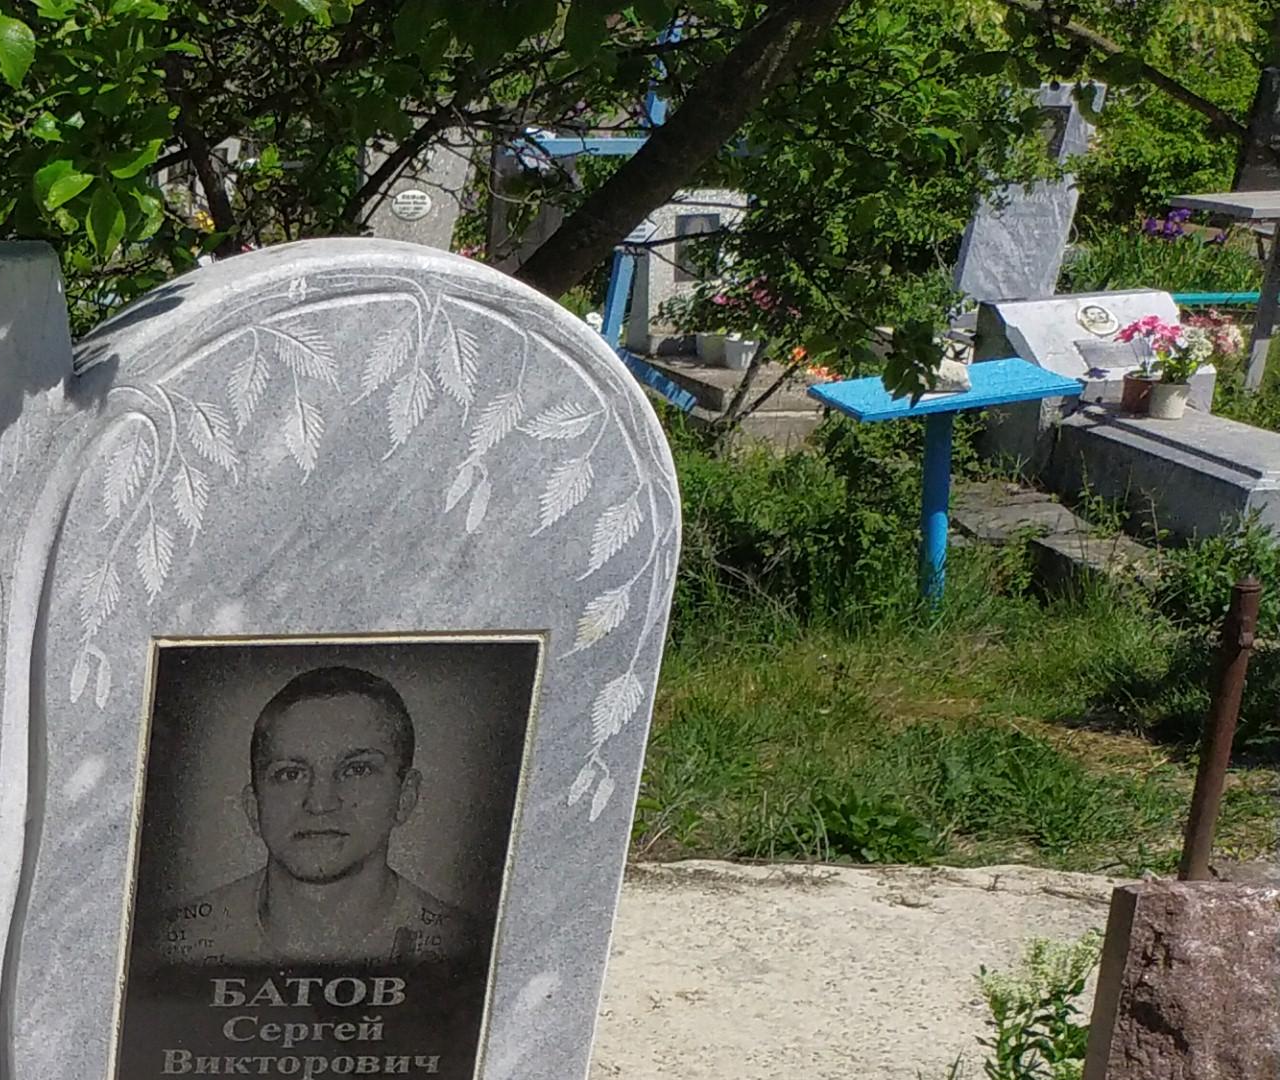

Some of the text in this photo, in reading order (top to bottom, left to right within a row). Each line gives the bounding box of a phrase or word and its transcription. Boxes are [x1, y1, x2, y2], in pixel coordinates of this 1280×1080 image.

[209, 977, 407, 1007] БАТОВ
[223, 1015, 384, 1048] Сергей
[160, 1049, 441, 1080] Викторович
